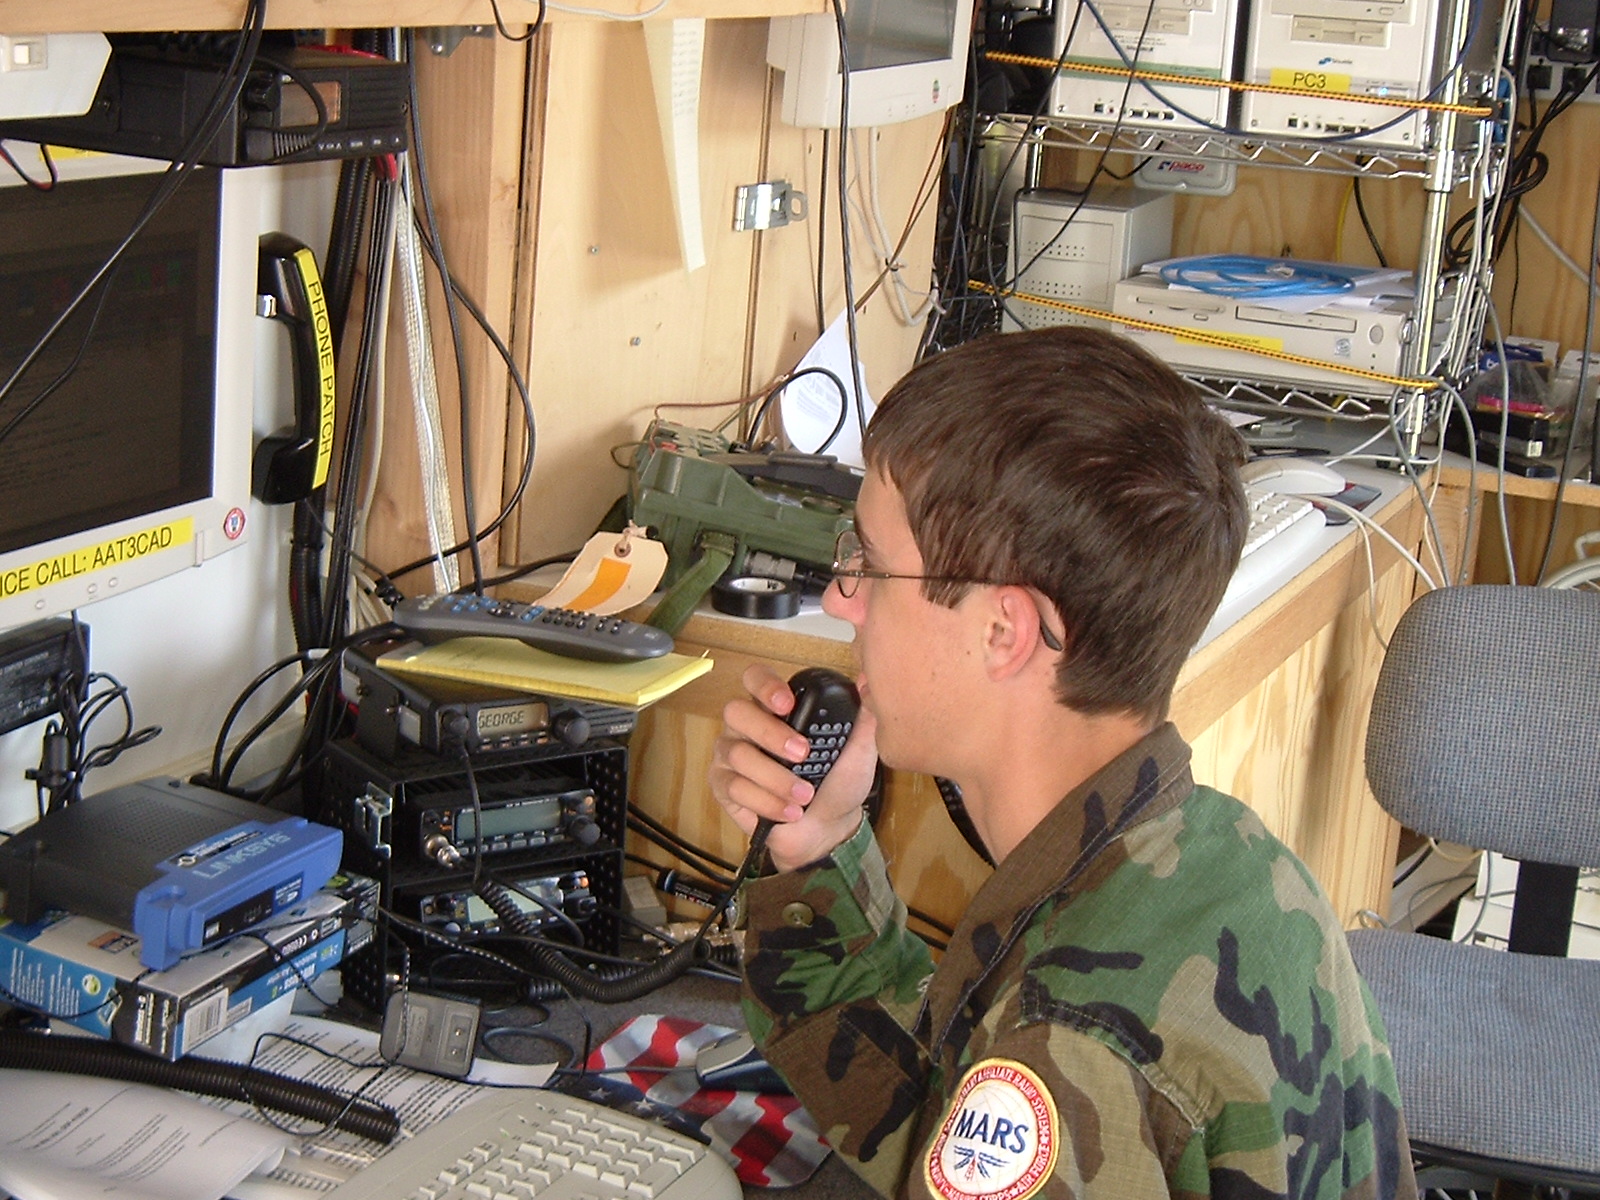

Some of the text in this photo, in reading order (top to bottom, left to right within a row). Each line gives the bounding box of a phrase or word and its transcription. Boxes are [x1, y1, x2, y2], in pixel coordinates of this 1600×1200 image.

[1293, 72, 1327, 89] PC3
[307, 281, 334, 456] PHONE PATCH
[36, 552, 87, 586] CALL:
[92, 526, 173, 570] AAT3CAD
[478, 710, 525, 729] GEORGE
[192, 832, 292, 879] LINKSYS
[953, 1108, 1029, 1154] MARS
